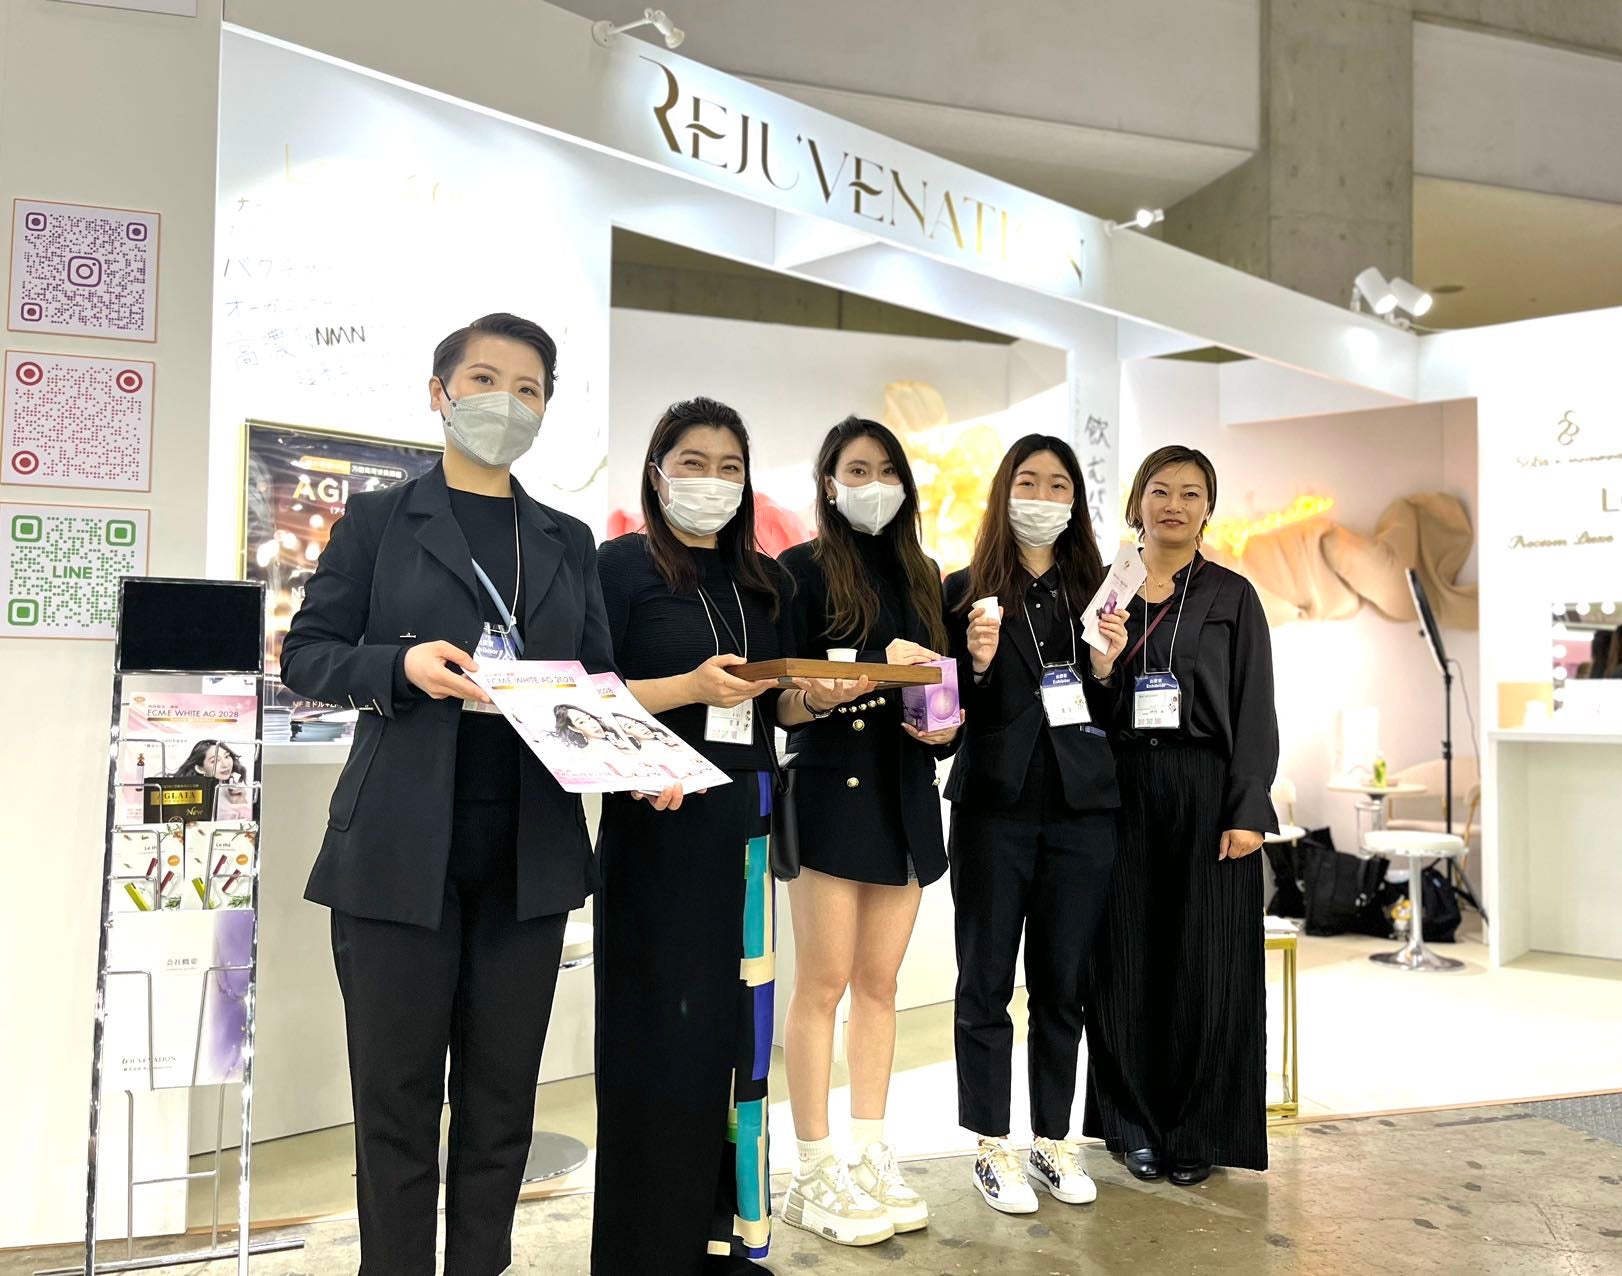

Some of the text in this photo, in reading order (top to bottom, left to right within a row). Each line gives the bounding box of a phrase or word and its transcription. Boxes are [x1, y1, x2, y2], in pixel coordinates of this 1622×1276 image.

[640, 55, 1085, 287] REJUVENATIN
[315, 325, 367, 347] NMN
[52, 565, 93, 580] LINE
[203, 710, 216, 718] AG
[218, 710, 240, 718] 2028
